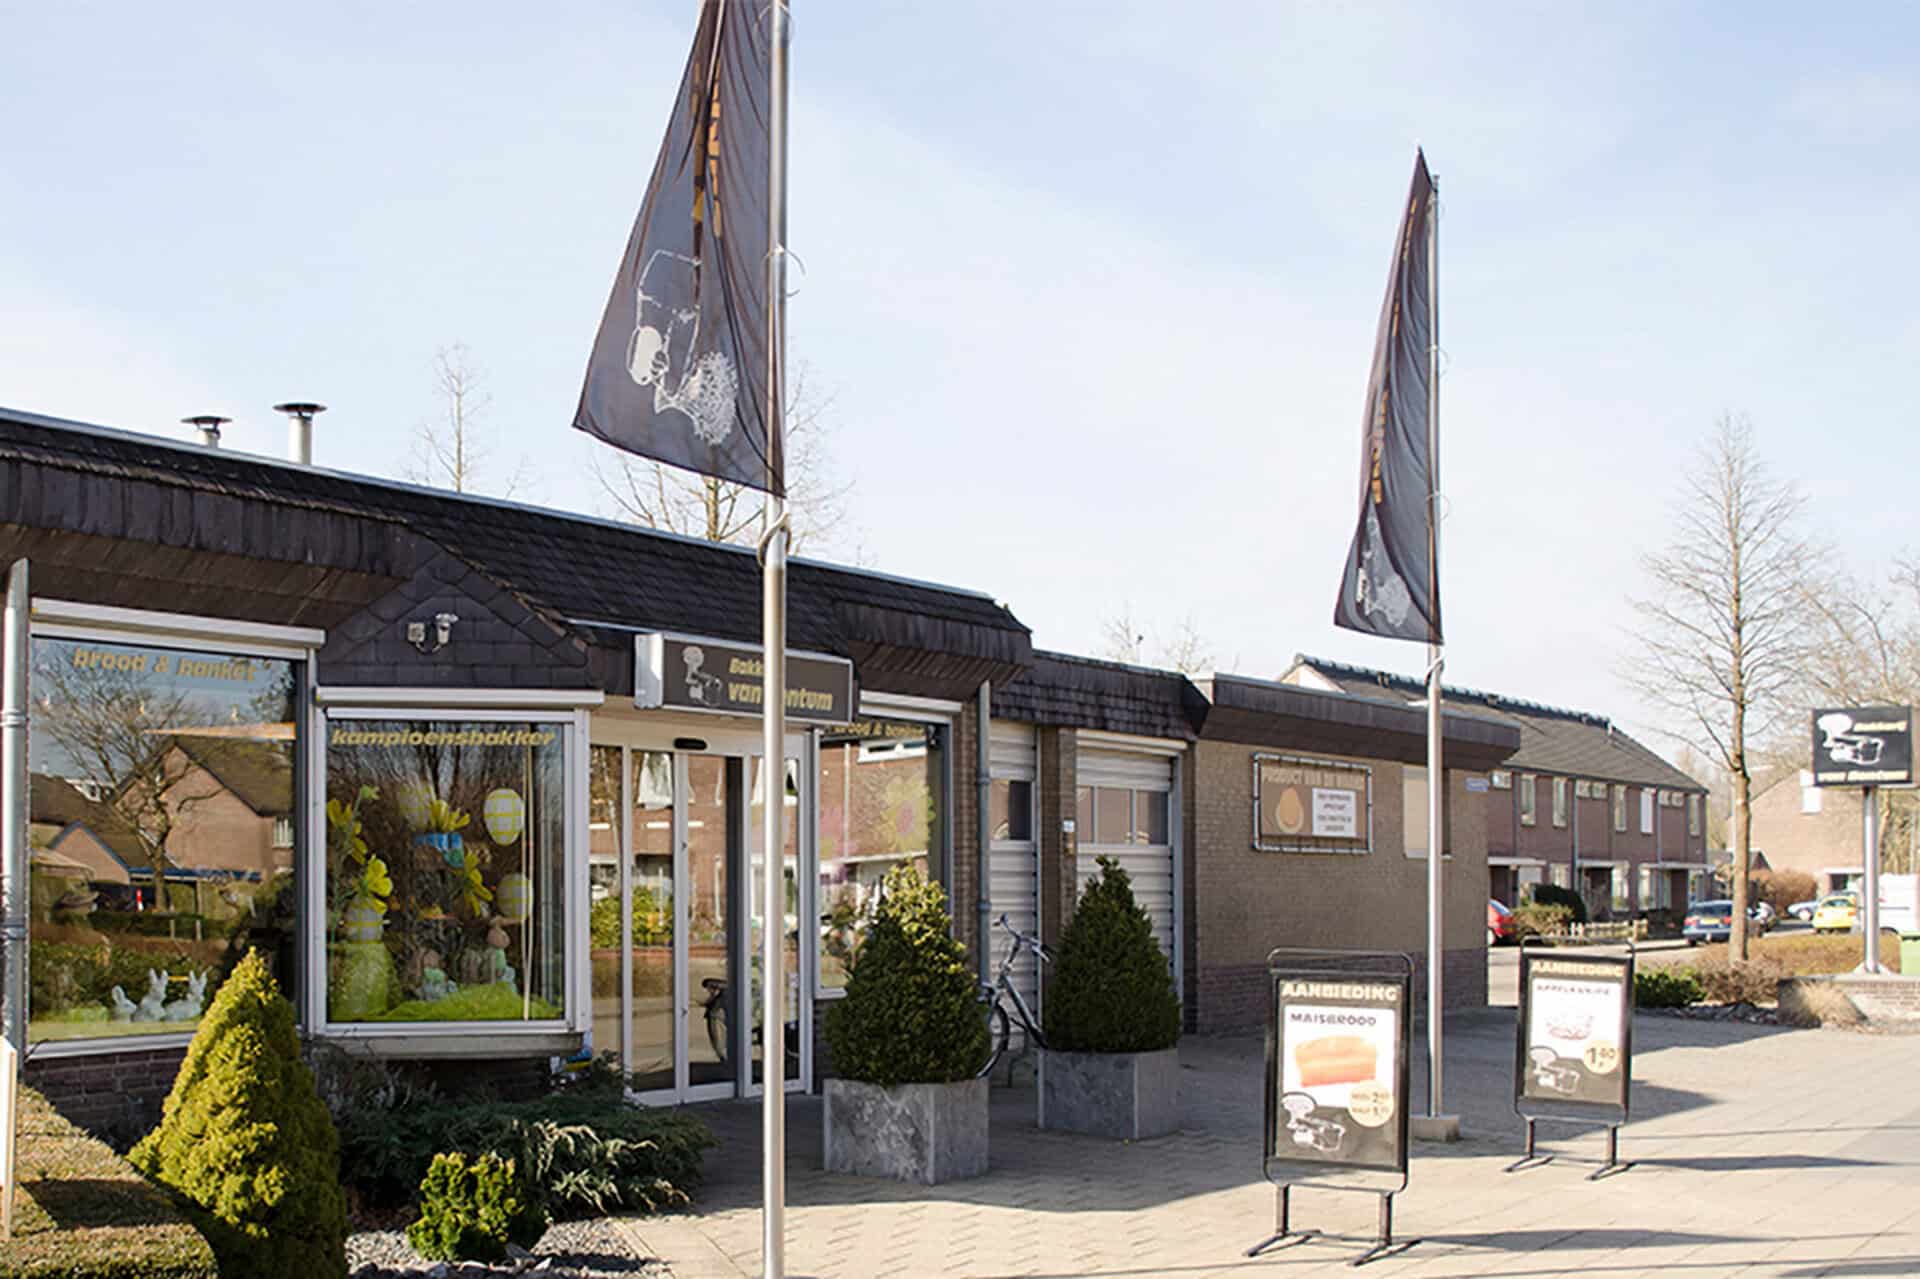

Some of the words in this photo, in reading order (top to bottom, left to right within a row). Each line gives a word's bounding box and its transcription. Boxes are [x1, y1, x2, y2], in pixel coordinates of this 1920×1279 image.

[73, 647, 148, 672] brood
[153, 655, 169, 673] &
[176, 657, 257, 682] banket
[728, 682, 762, 704] van
[331, 729, 556, 748] kampioensbakker
[1281, 981, 1398, 1001] AANBIEDING
[1290, 1012, 1376, 1027] MAISBROOD
